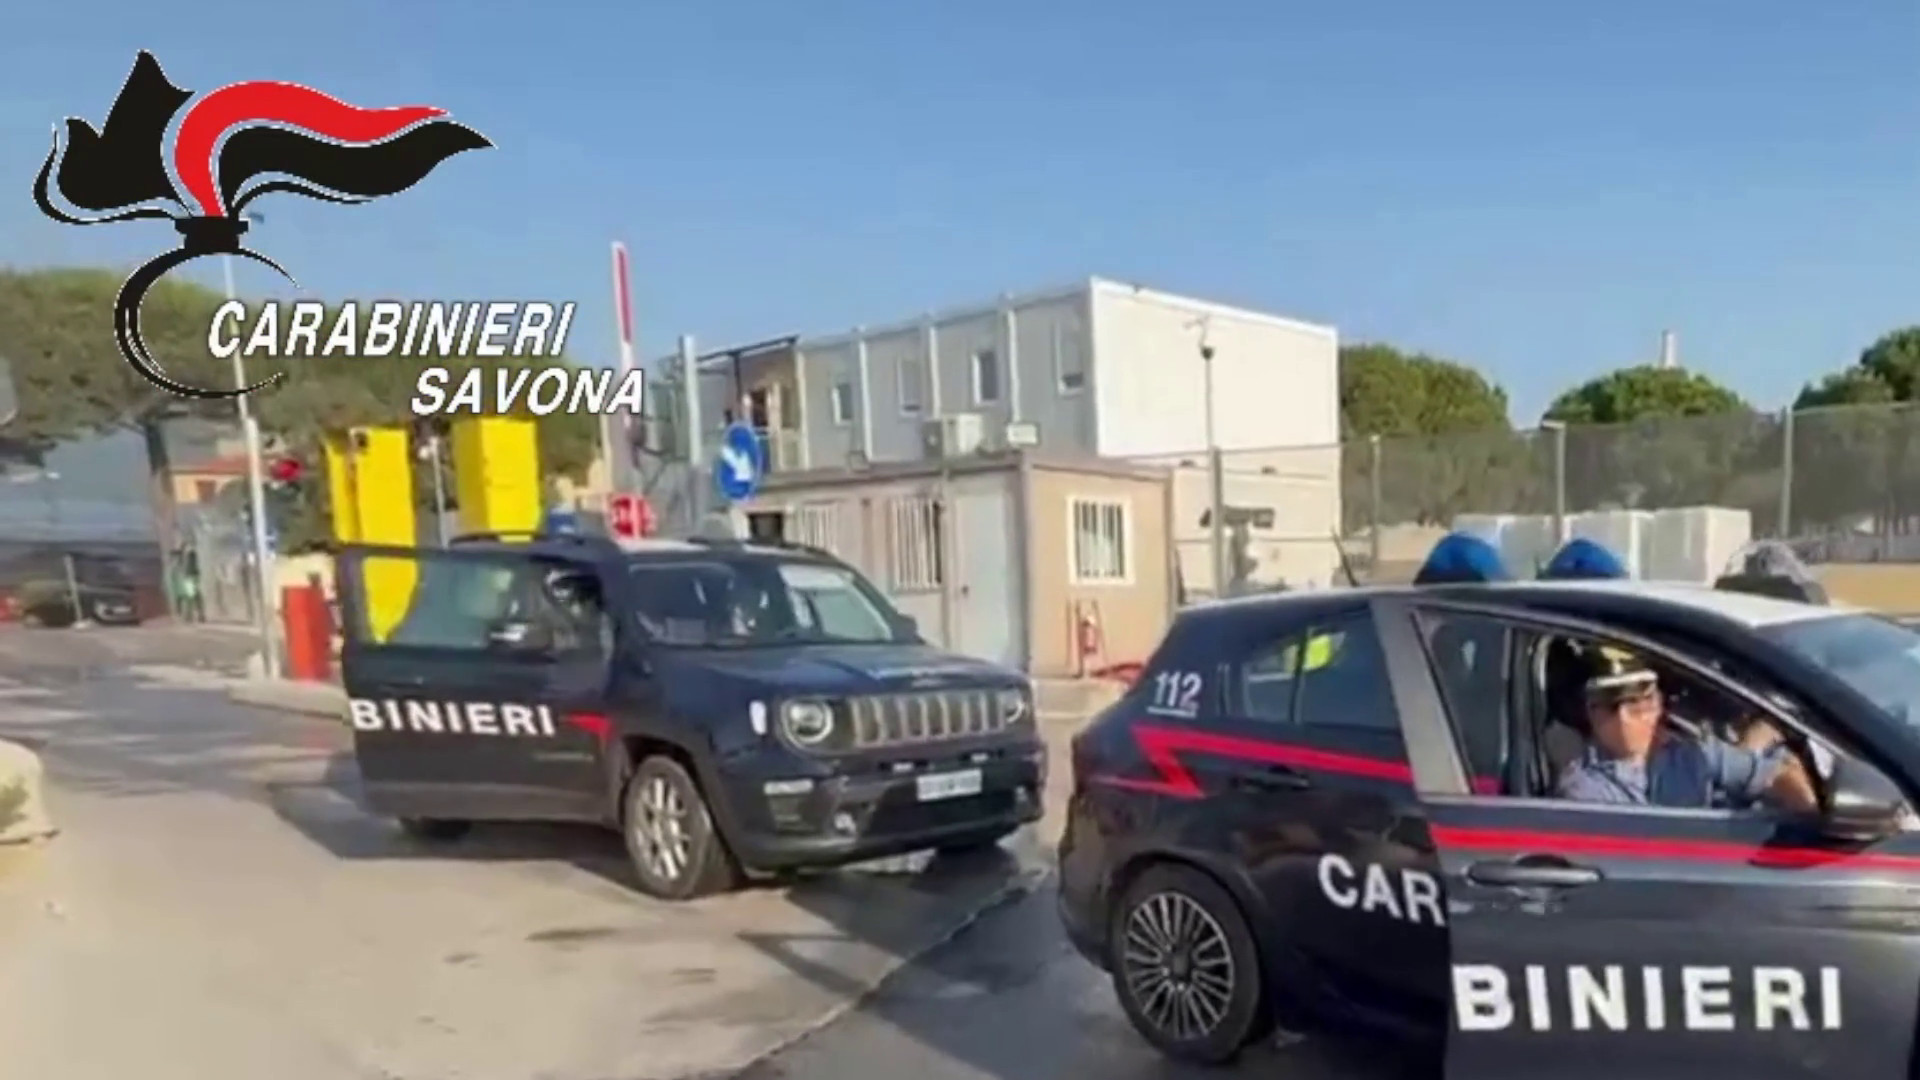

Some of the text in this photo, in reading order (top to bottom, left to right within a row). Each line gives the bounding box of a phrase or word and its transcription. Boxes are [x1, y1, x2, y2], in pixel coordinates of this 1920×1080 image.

[1153, 671, 1202, 706] 112
[350, 698, 556, 737] BINIERI
[1318, 852, 1446, 927] CAR
[1451, 963, 1843, 1032] BINIERI
